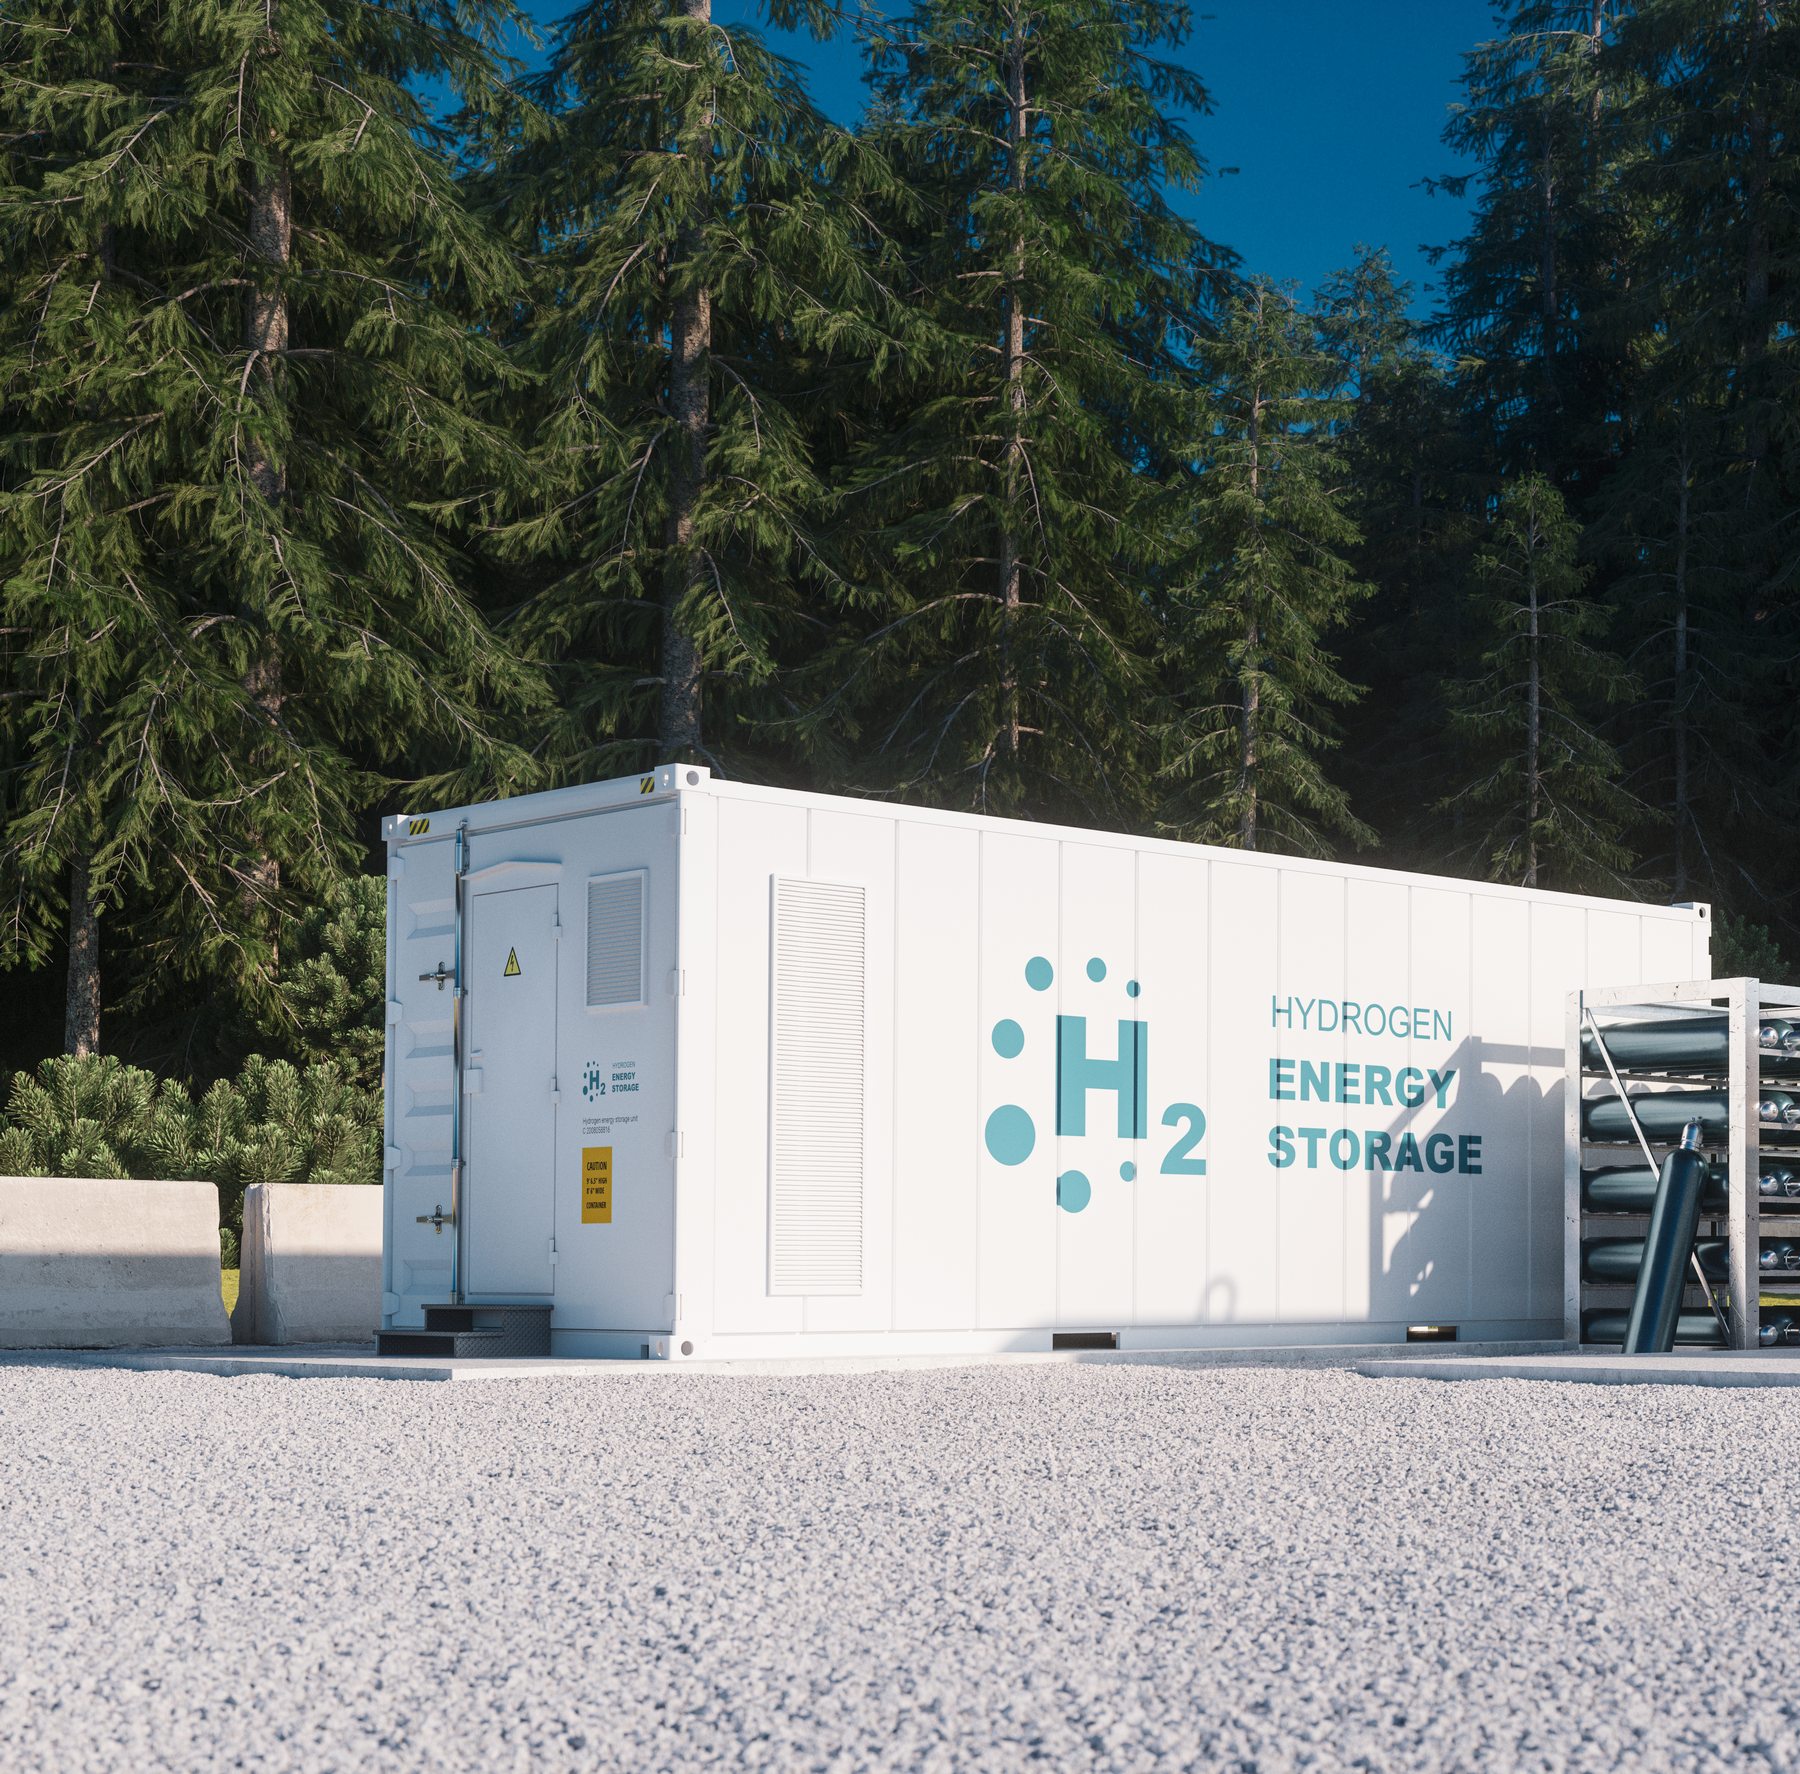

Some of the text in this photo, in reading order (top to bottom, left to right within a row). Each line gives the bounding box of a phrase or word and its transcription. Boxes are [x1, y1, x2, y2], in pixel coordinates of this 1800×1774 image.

[1272, 995, 1453, 1042] HYDROGEN
[612, 1061, 636, 1069] HYDROGEN
[612, 1072, 636, 1081] ENERGY
[589, 1070, 606, 1096] H2
[612, 1083, 640, 1093] STORAGE
[1269, 1058, 1457, 1109] ENERGY
[1055, 1014, 1207, 1176] H2
[583, 1117, 601, 1126] Hydrogen
[602, 1117, 615, 1125] energy
[615, 1116, 629, 1124] storage
[1267, 1125, 1483, 1175] STORAGE
[586, 1161, 607, 1171] CAUTION
[586, 1201, 607, 1209] CONTAINER
